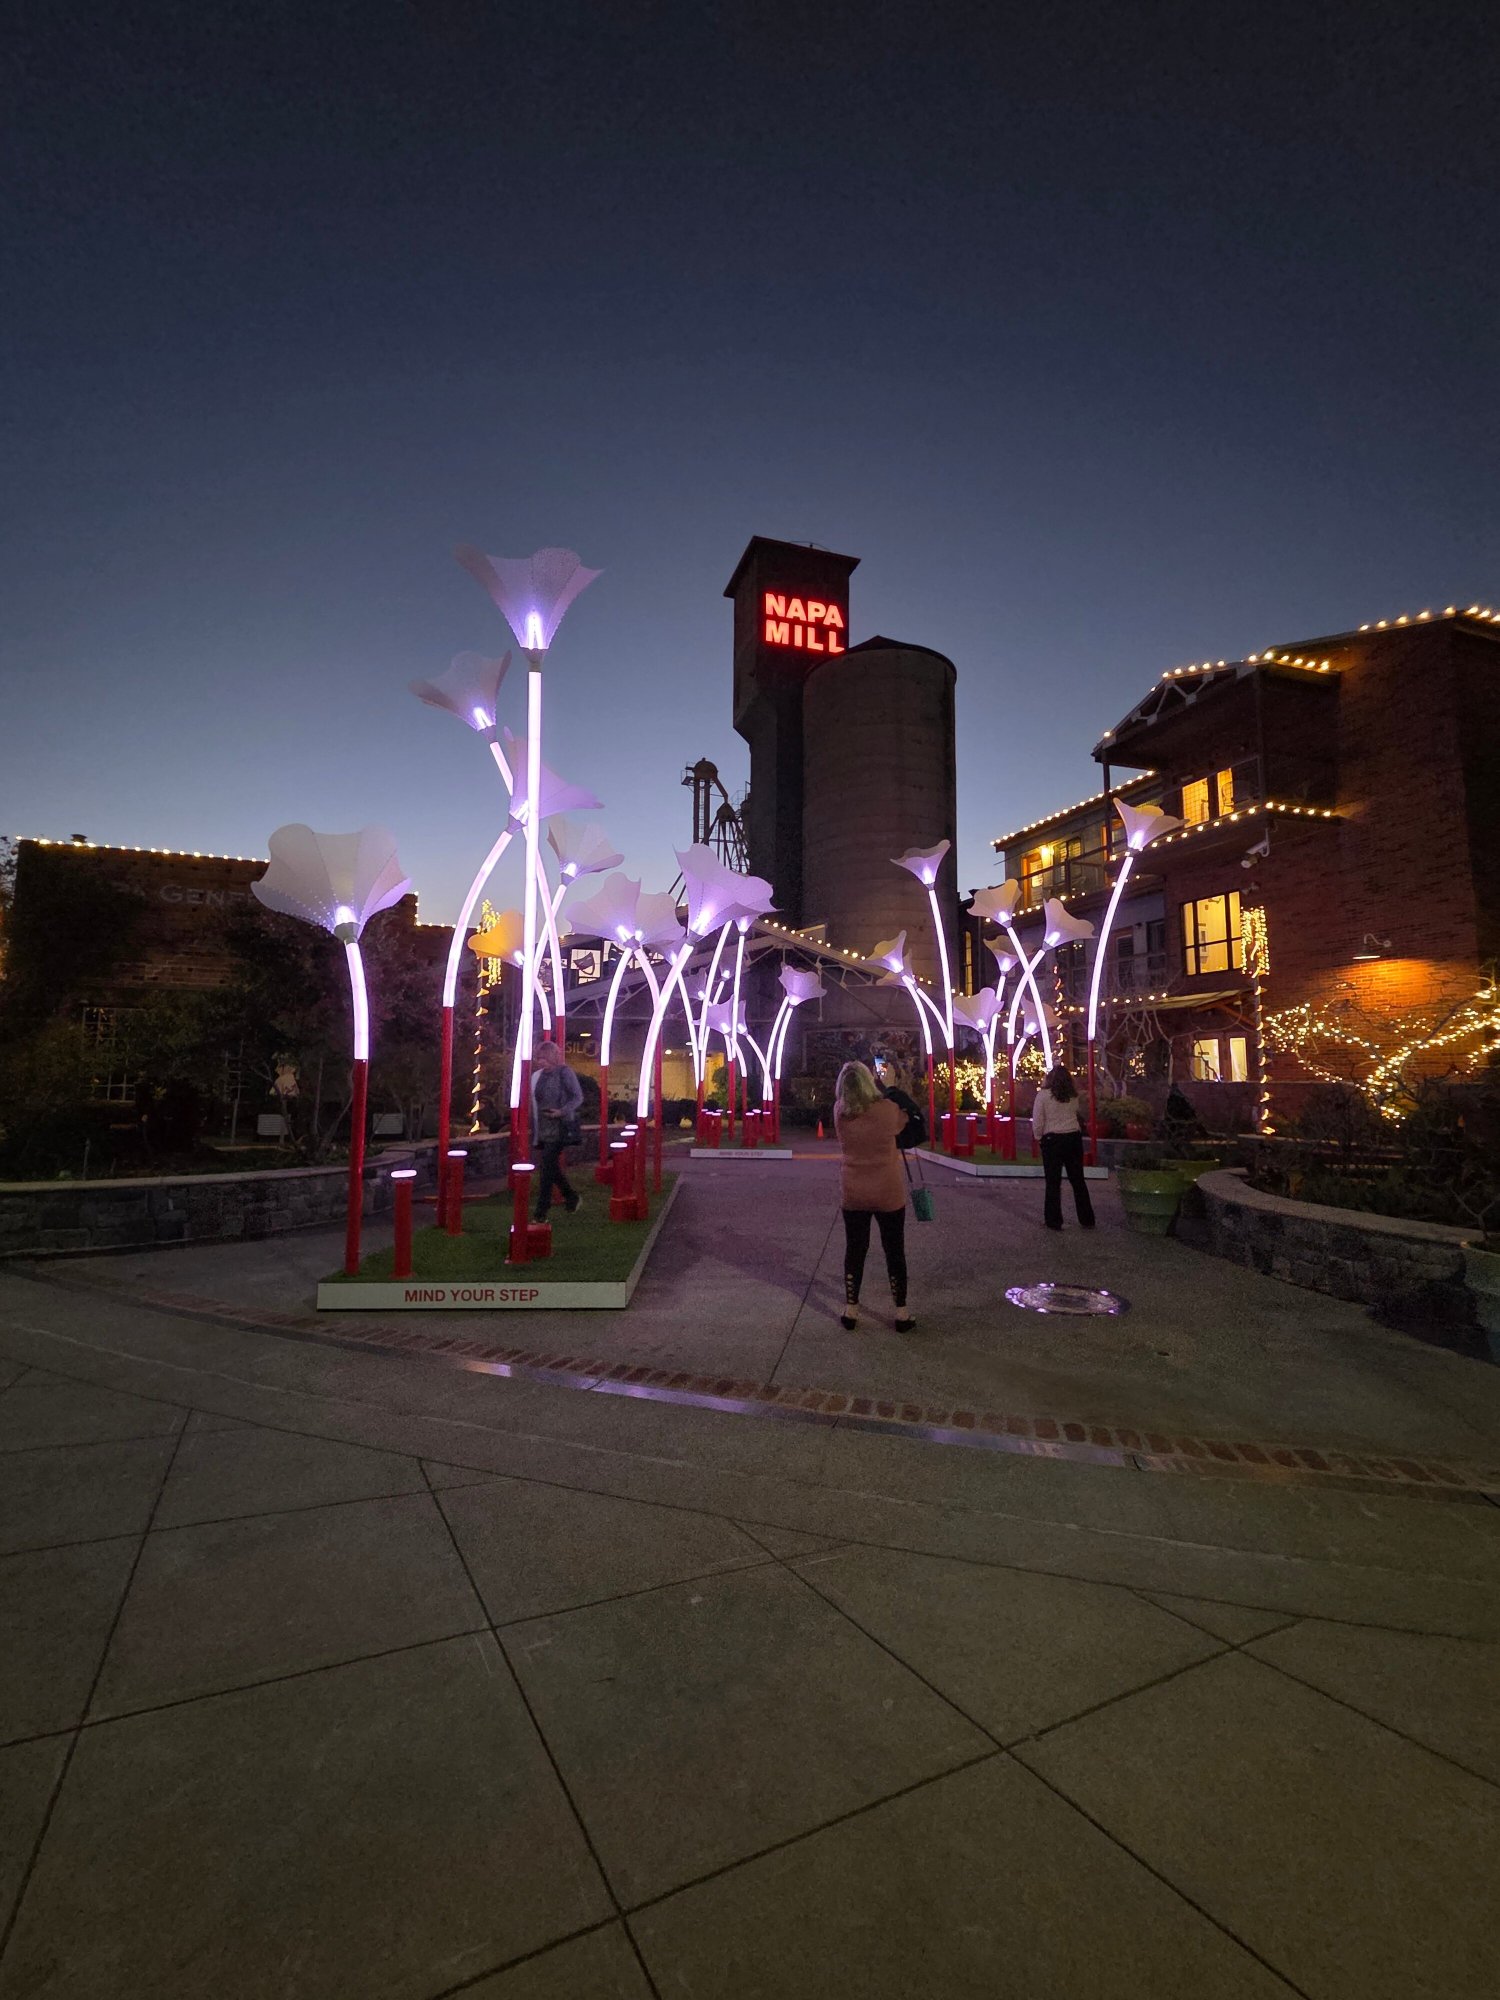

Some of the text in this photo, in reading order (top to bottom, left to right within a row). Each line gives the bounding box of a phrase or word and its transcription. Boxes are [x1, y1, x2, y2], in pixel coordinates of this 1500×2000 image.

[765, 593, 844, 628] NAPA
[765, 619, 845, 653] MILL
[404, 1289, 539, 1302] MIND YOUR STEP
